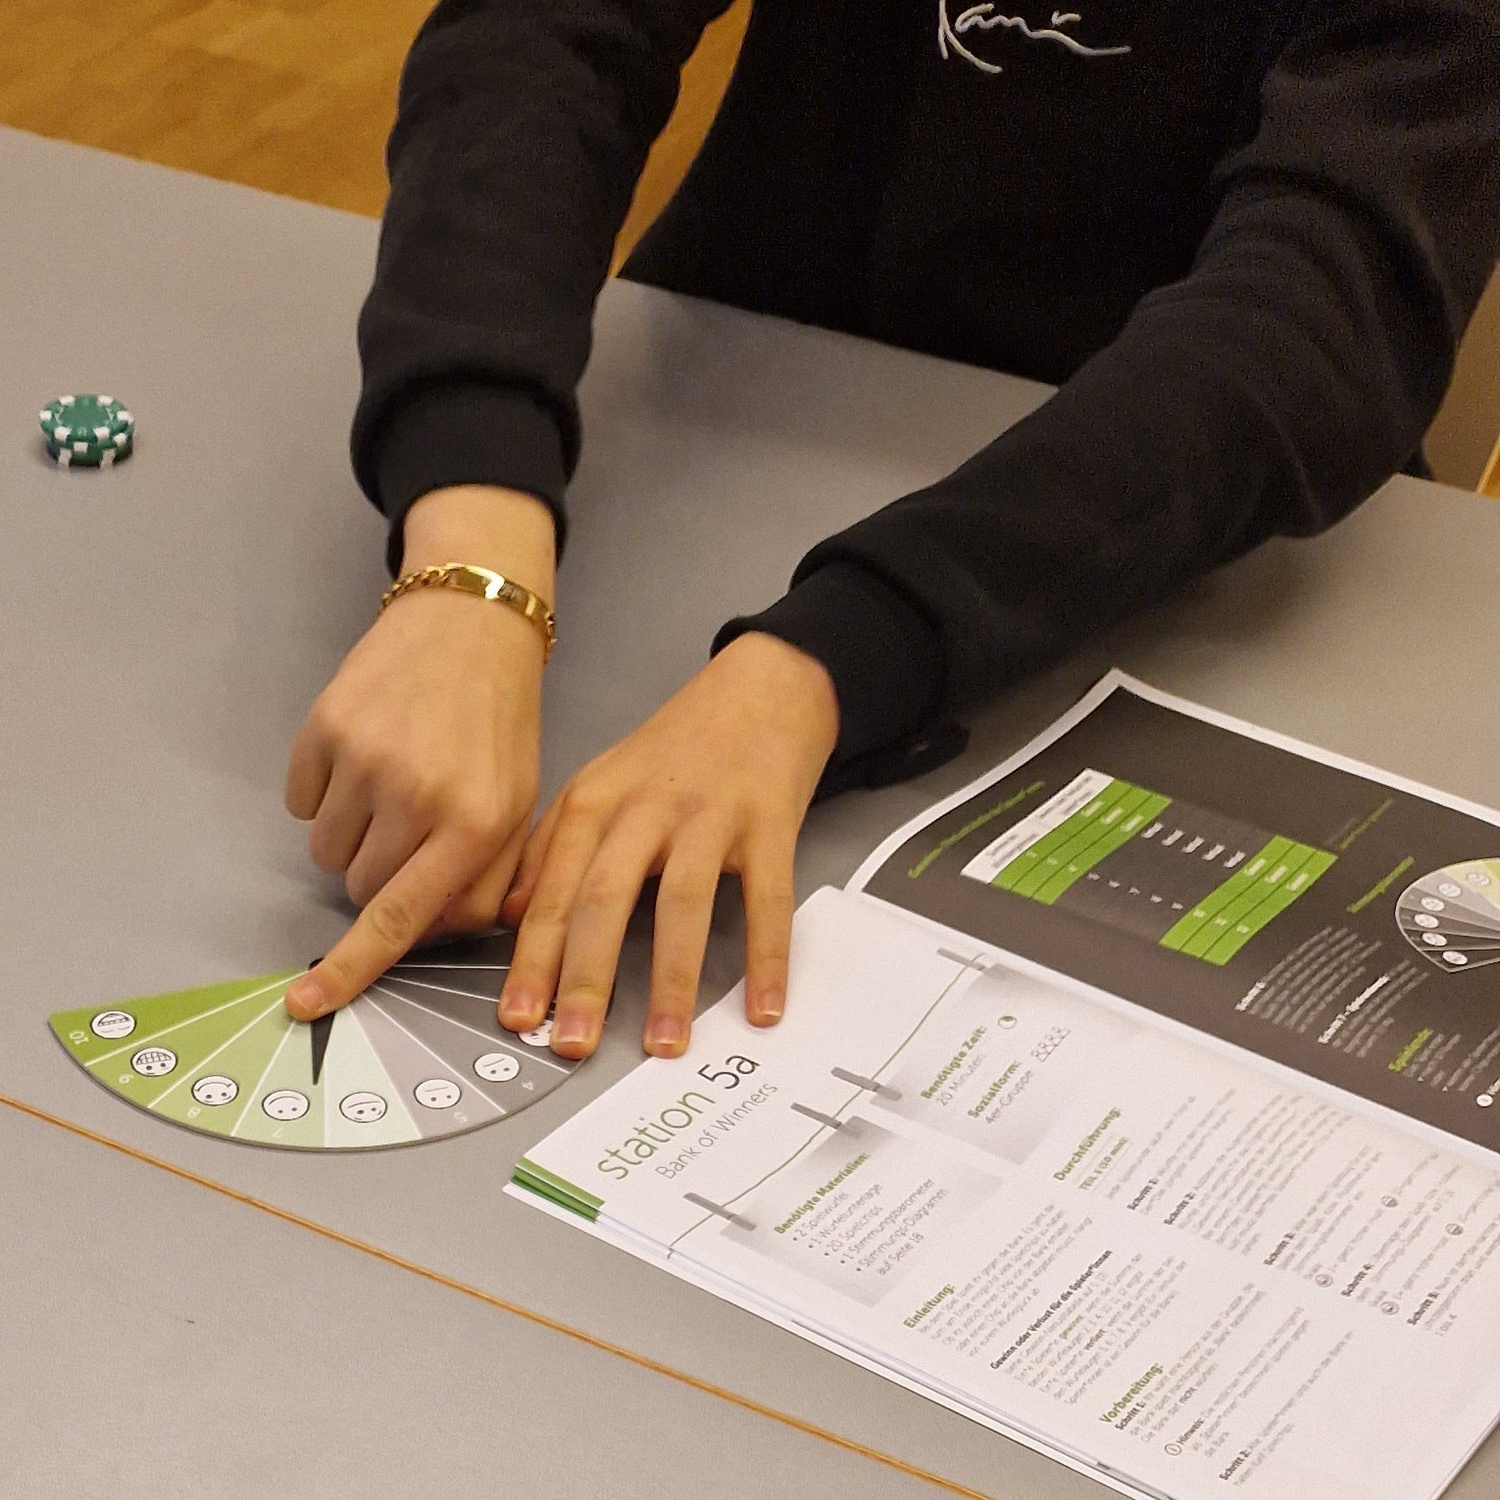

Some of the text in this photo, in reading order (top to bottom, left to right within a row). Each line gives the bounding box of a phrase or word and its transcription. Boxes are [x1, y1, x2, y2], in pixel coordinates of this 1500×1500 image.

[920, 1049, 968, 1101] Benötigte
[597, 1054, 761, 1182] station 5a
[655, 1082, 779, 1181] Bank of Winners
[773, 1195, 821, 1235] Benötigte
[903, 1283, 956, 1330] Einleitung:
[1100, 1362, 1165, 1424] Vorbereitung:
